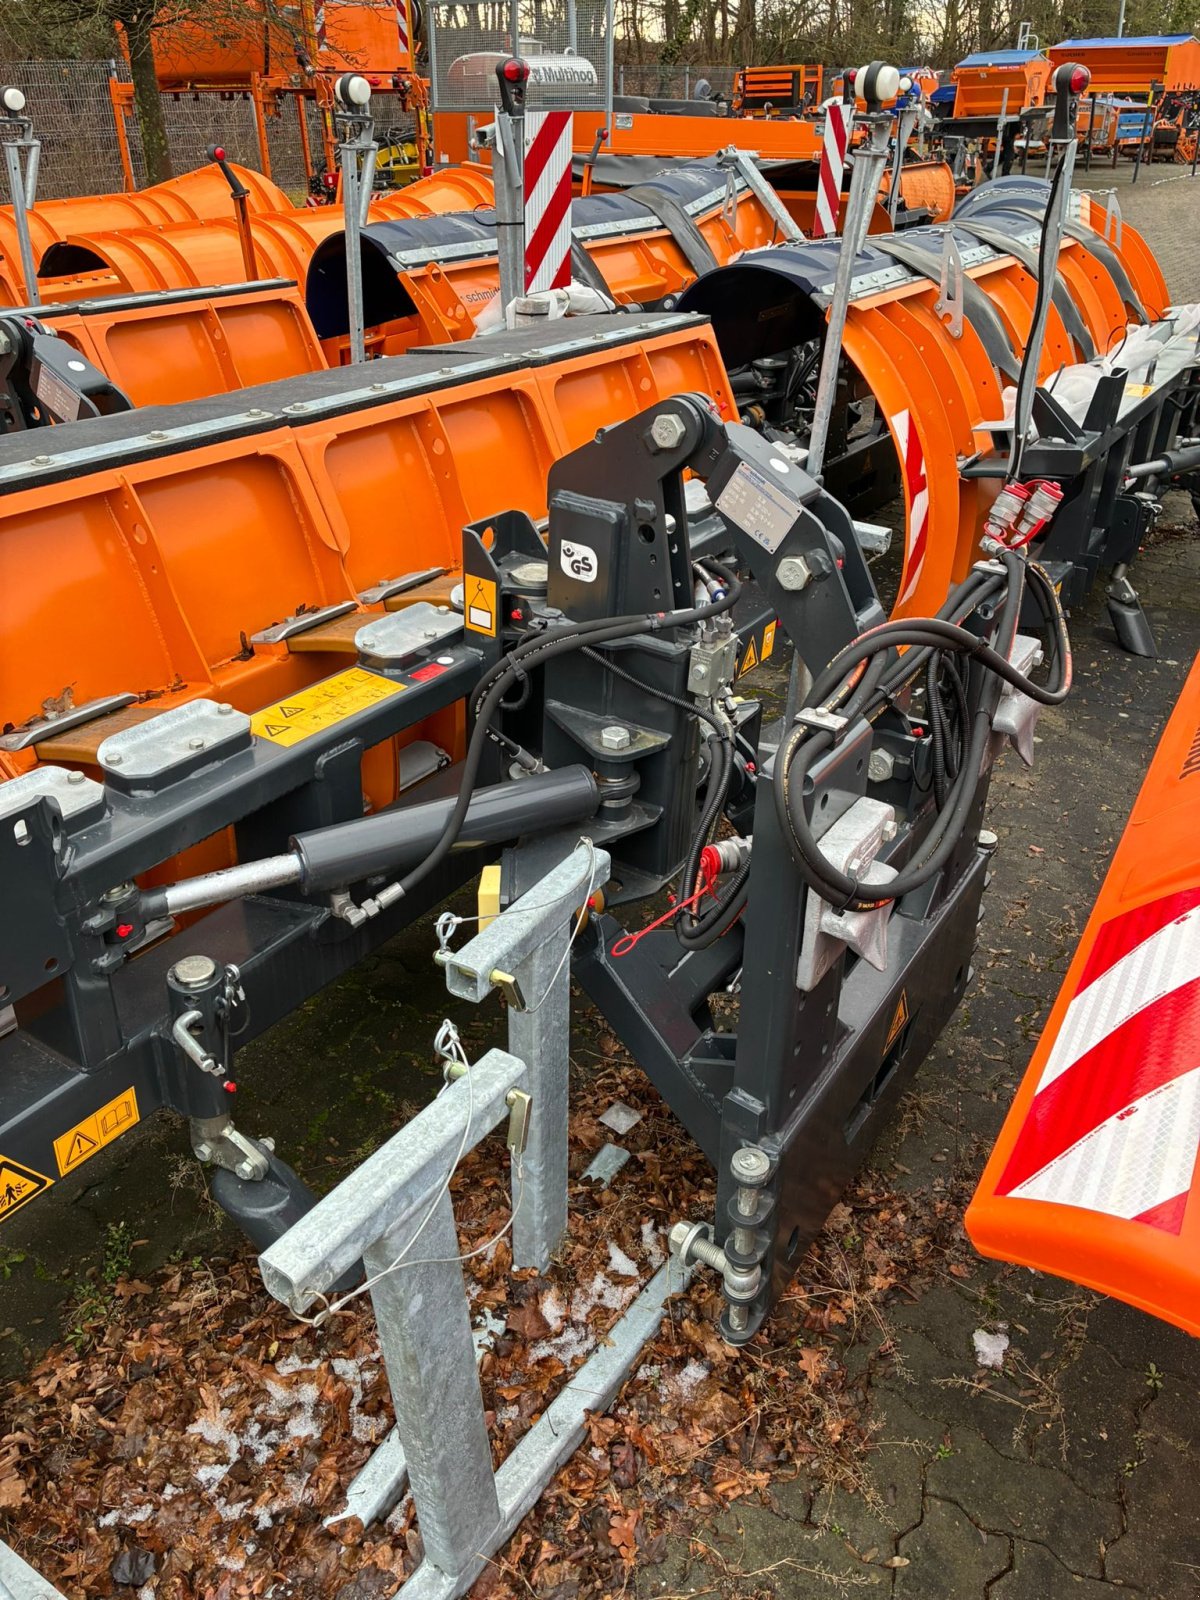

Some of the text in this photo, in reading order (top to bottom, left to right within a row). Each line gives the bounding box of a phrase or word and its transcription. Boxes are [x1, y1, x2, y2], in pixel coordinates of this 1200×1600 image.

[542, 66, 594, 86] Multihog
[570, 556, 593, 575] GS
[1116, 1105, 1139, 1121] 3M
